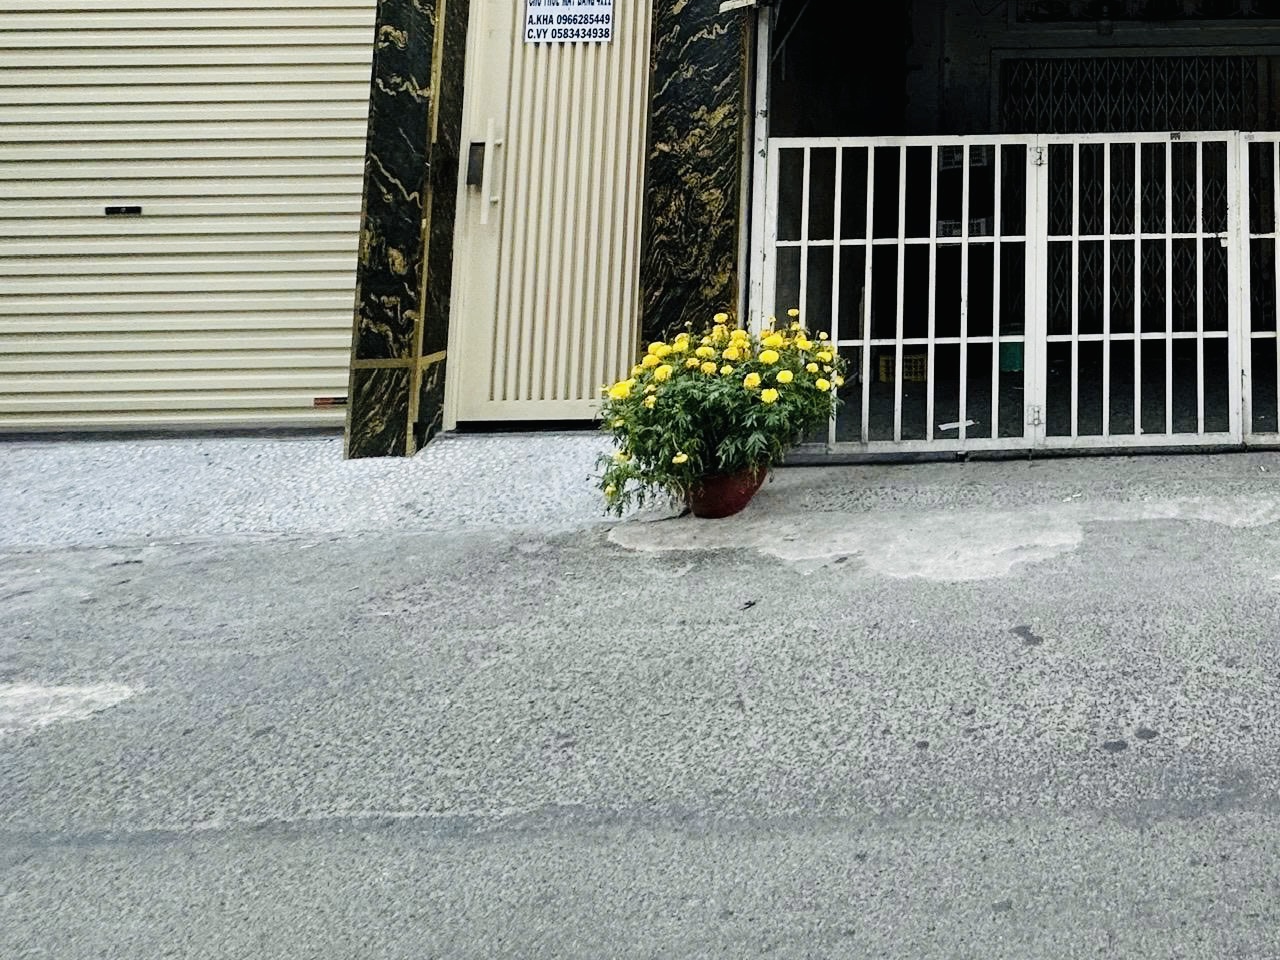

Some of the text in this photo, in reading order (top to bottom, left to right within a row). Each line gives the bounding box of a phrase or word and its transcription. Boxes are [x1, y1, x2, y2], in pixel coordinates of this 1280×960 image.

[528, 13, 610, 25] A.KHA 0966285449
[527, 27, 610, 39] C.VY 0583434938
